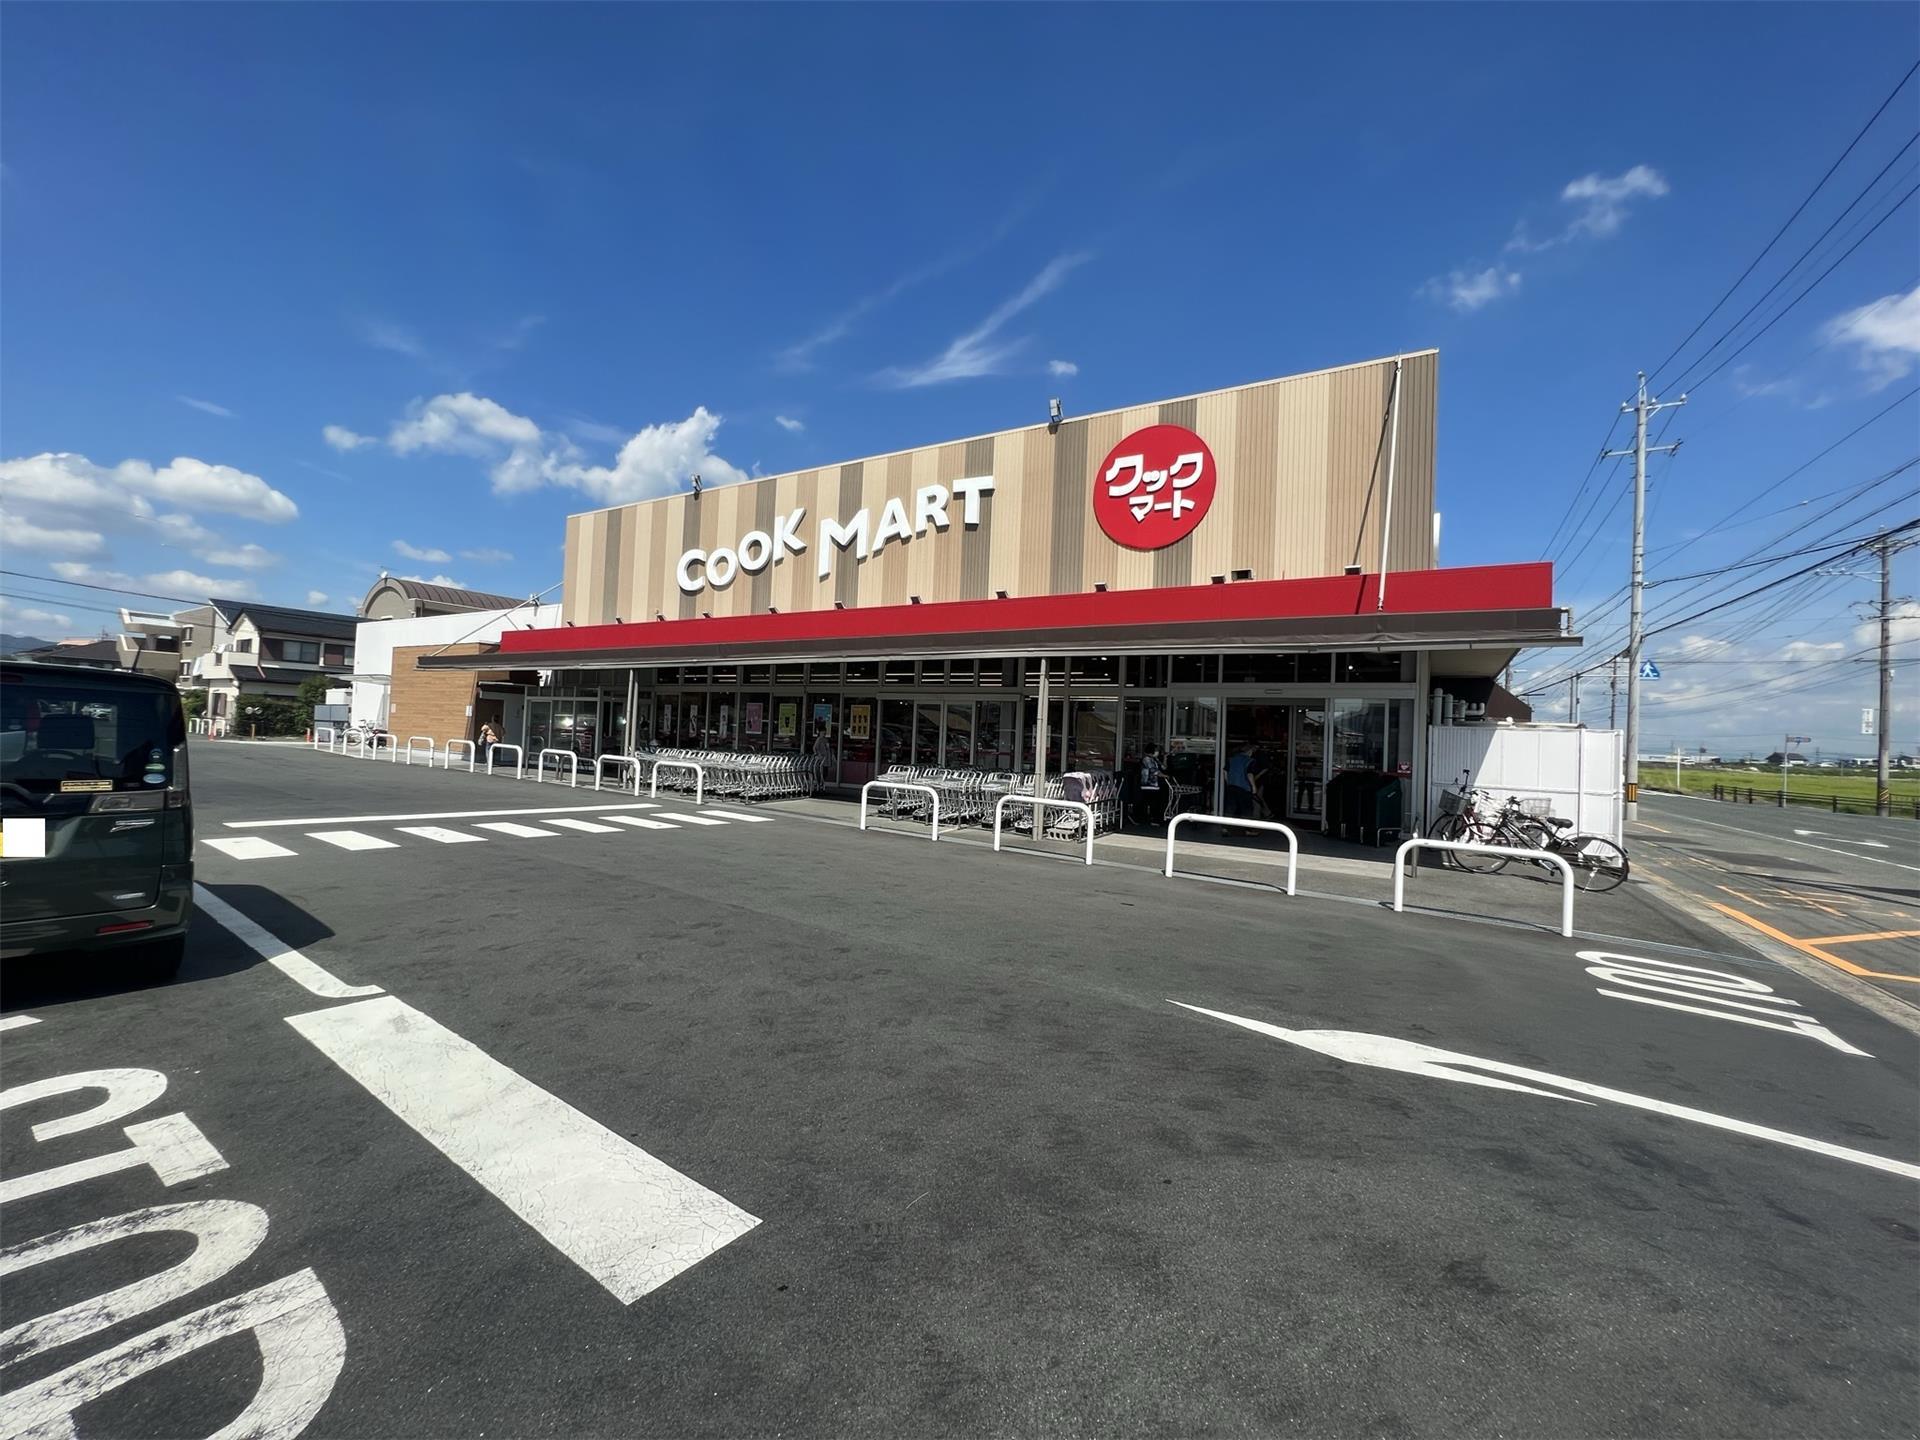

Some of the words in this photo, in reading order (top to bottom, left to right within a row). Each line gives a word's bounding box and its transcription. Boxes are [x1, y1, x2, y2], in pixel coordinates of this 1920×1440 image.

[1105, 451, 1204, 497] クック
[1128, 489, 1196, 522] マート
[675, 506, 809, 593] COOK
[817, 475, 996, 580] MART
